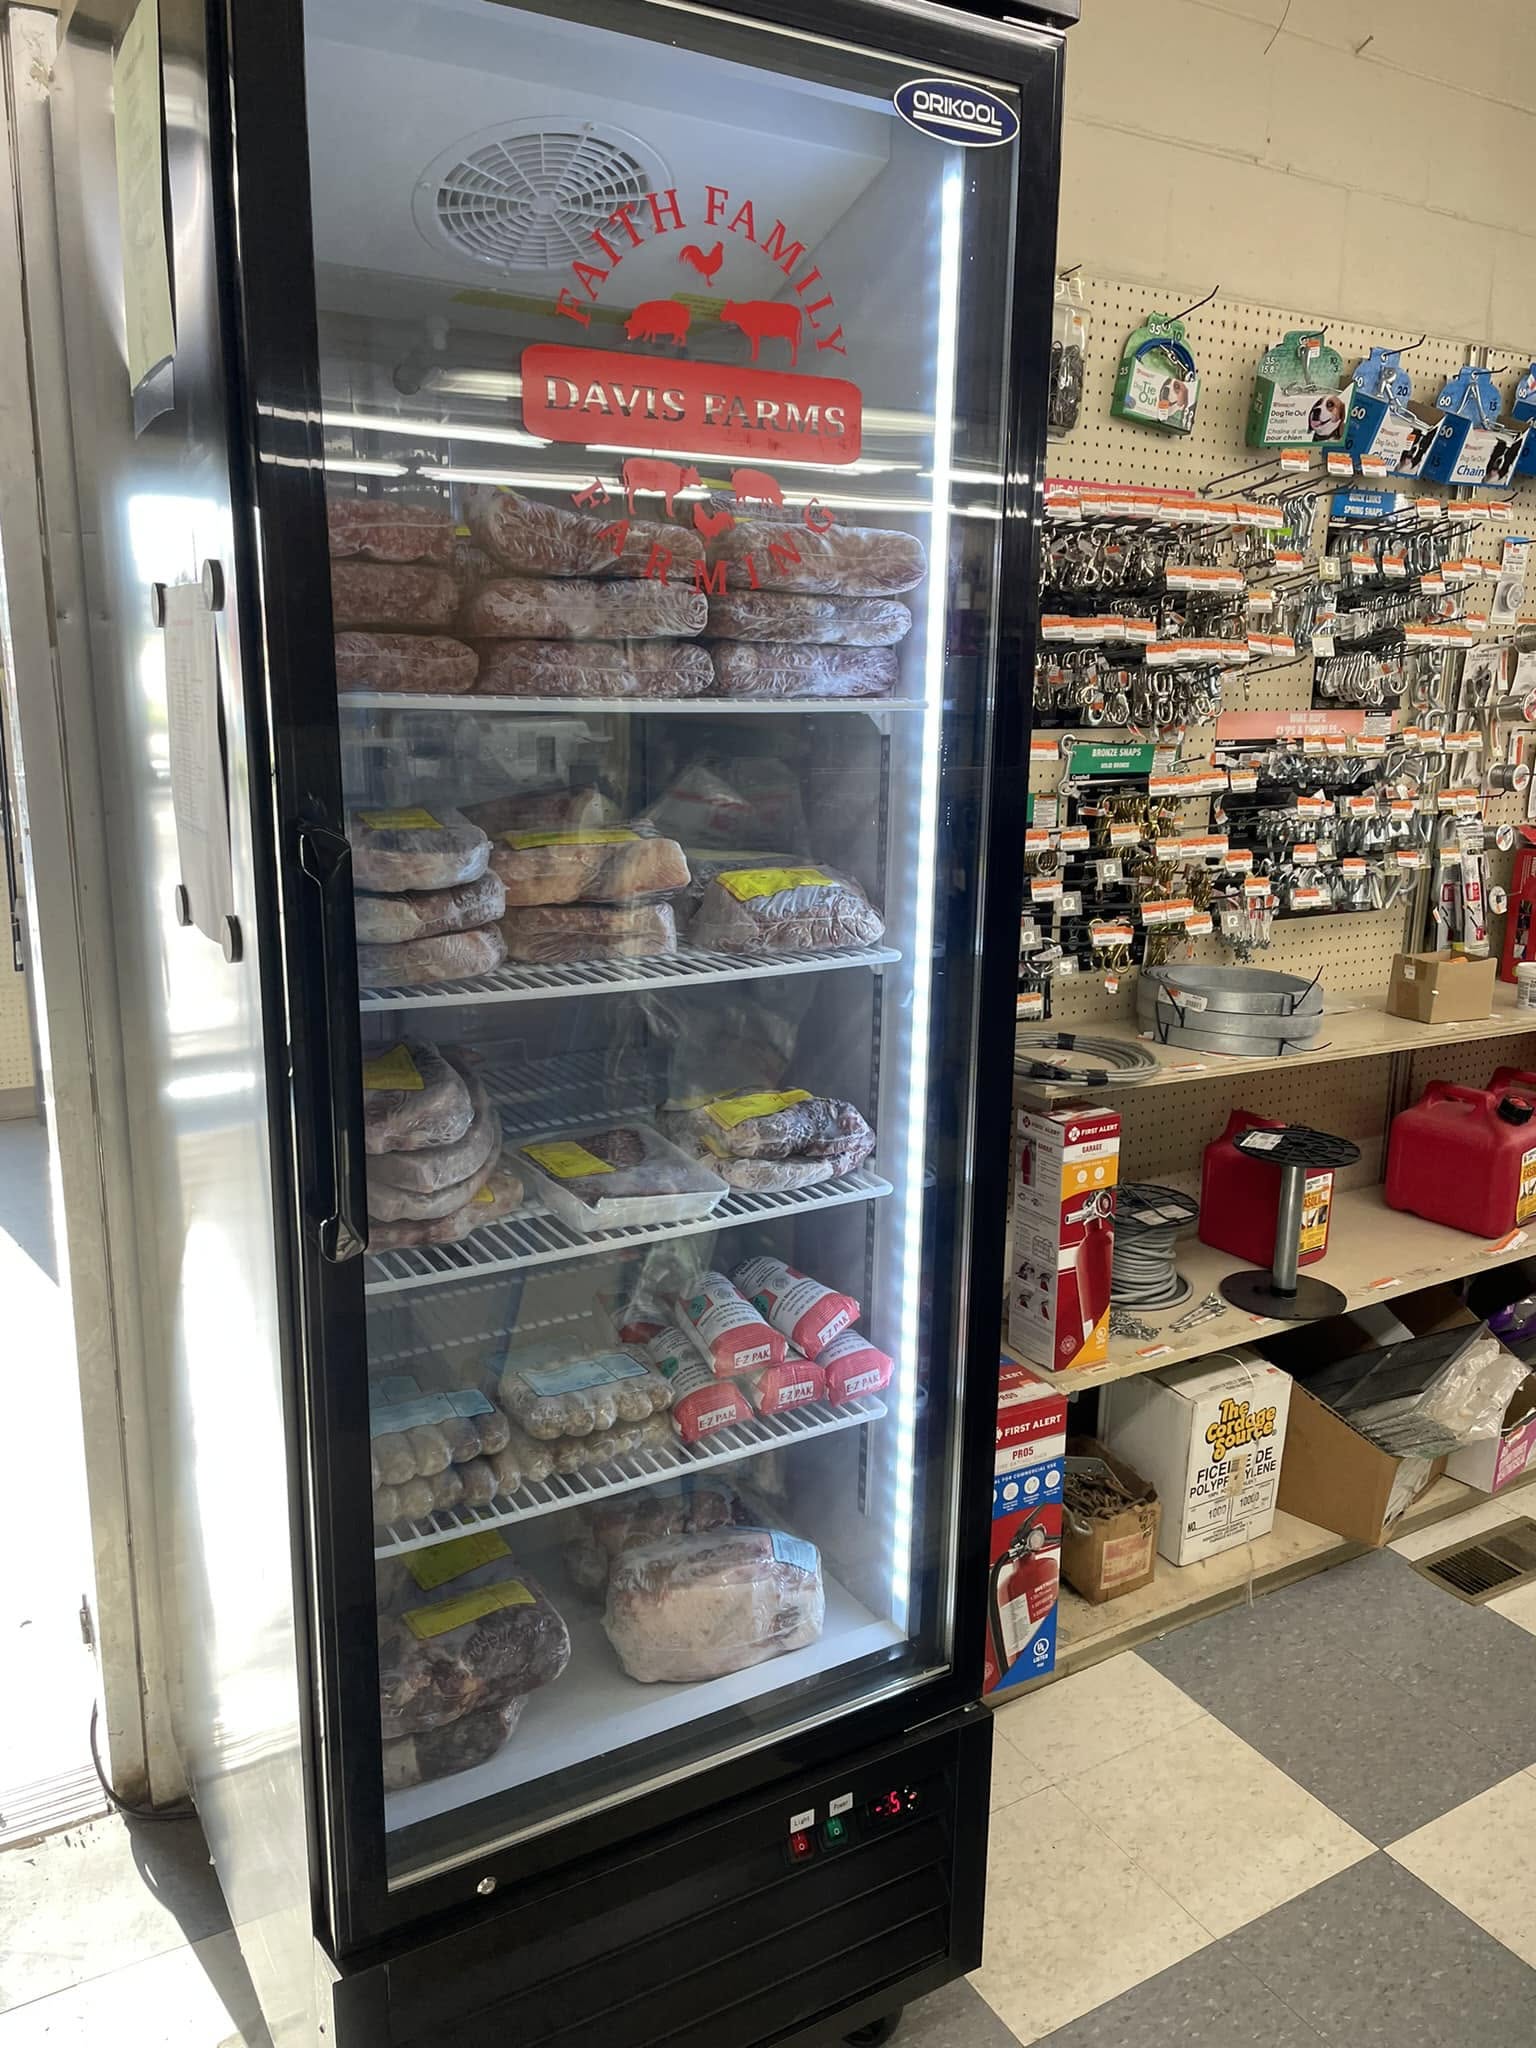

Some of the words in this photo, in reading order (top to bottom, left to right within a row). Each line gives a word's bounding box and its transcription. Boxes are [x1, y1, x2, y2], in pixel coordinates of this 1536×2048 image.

[913, 90, 1002, 126] ORIKOOL
[555, 188, 686, 329] FAITH
[704, 185, 847, 356] FAMILY
[1149, 323, 1160, 335] 35
[1143, 381, 1157, 395] Tie
[1397, 386, 1408, 396] 20
[543, 375, 685, 422] DAVIS
[701, 392, 846, 438] FARMS
[1439, 396, 1451, 406] 60
[1271, 410, 1284, 418] Dog
[1351, 406, 1366, 419] 60
[1457, 464, 1485, 477] Chain
[569, 477, 836, 597] FARMING
[1092, 748, 1118, 758] BRONZE
[1119, 747, 1142, 757] SNAPS
[1081, 1127, 1098, 1137] FIRST
[1100, 1123, 1119, 1133] ALERT
[1082, 1143, 1102, 1154] GARAGE
[834, 1315, 849, 1331] PAK
[735, 1354, 750, 1366] E-Z
[752, 1349, 769, 1361] PAK
[846, 1381, 859, 1393] E-Z
[861, 1374, 880, 1389] PAK
[780, 1390, 793, 1402] E-Z
[794, 1387, 813, 1399] PAK
[715, 1409, 736, 1423] PAK
[1219, 1398, 1250, 1423] The
[1004, 1422, 1031, 1438] FIRST
[1032, 1414, 1062, 1430] ALERT
[1205, 1406, 1277, 1444] Cordage
[1212, 1420, 1274, 1463] Source
[1255, 1447, 1273, 1464] DE
